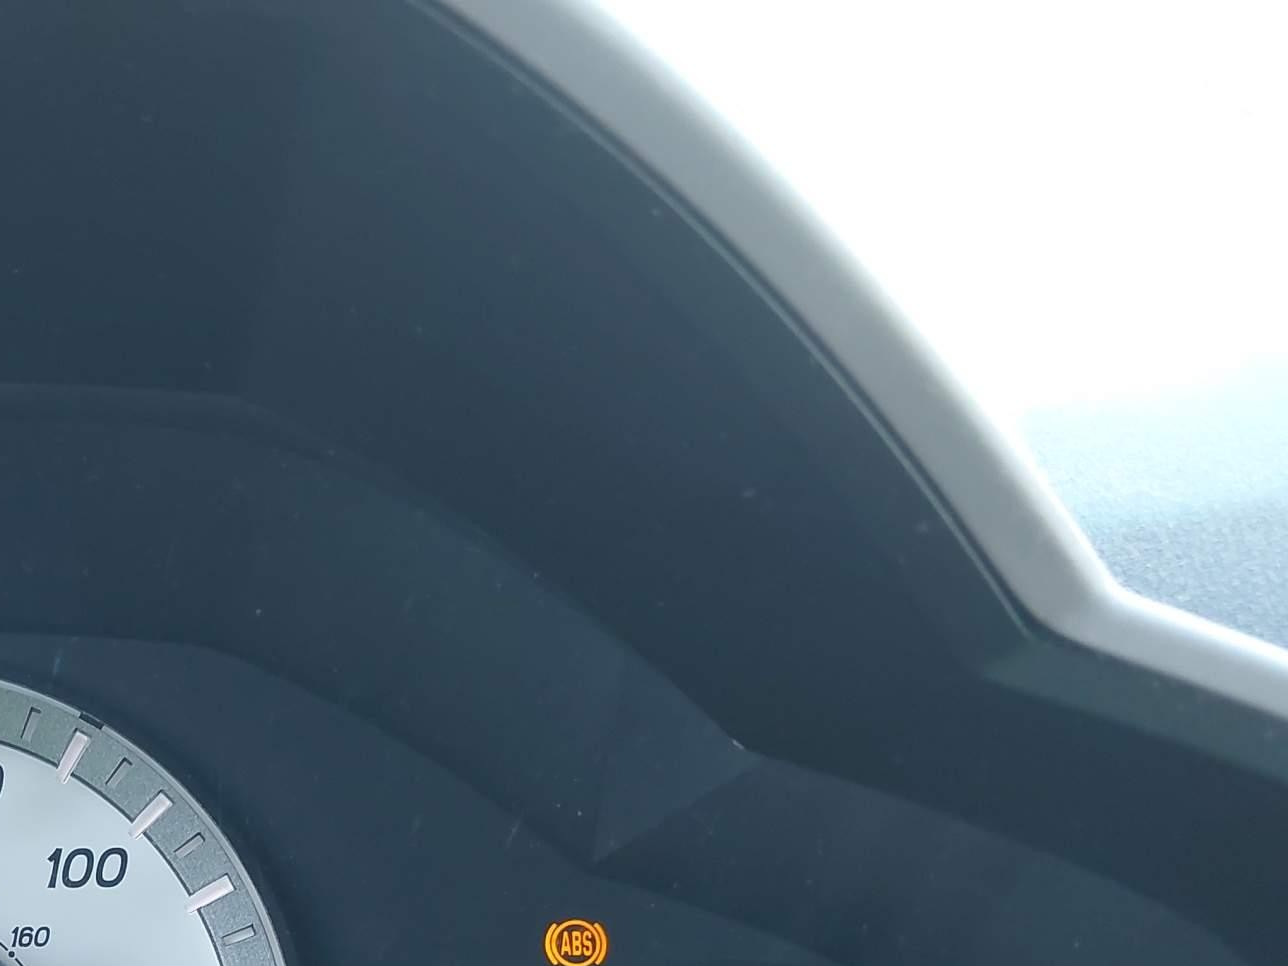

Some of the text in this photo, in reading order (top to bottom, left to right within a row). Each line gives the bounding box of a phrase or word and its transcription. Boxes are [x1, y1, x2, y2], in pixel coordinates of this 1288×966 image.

[48, 847, 128, 890] 100
[11, 926, 50, 948] 160
[560, 930, 593, 957] ABS
